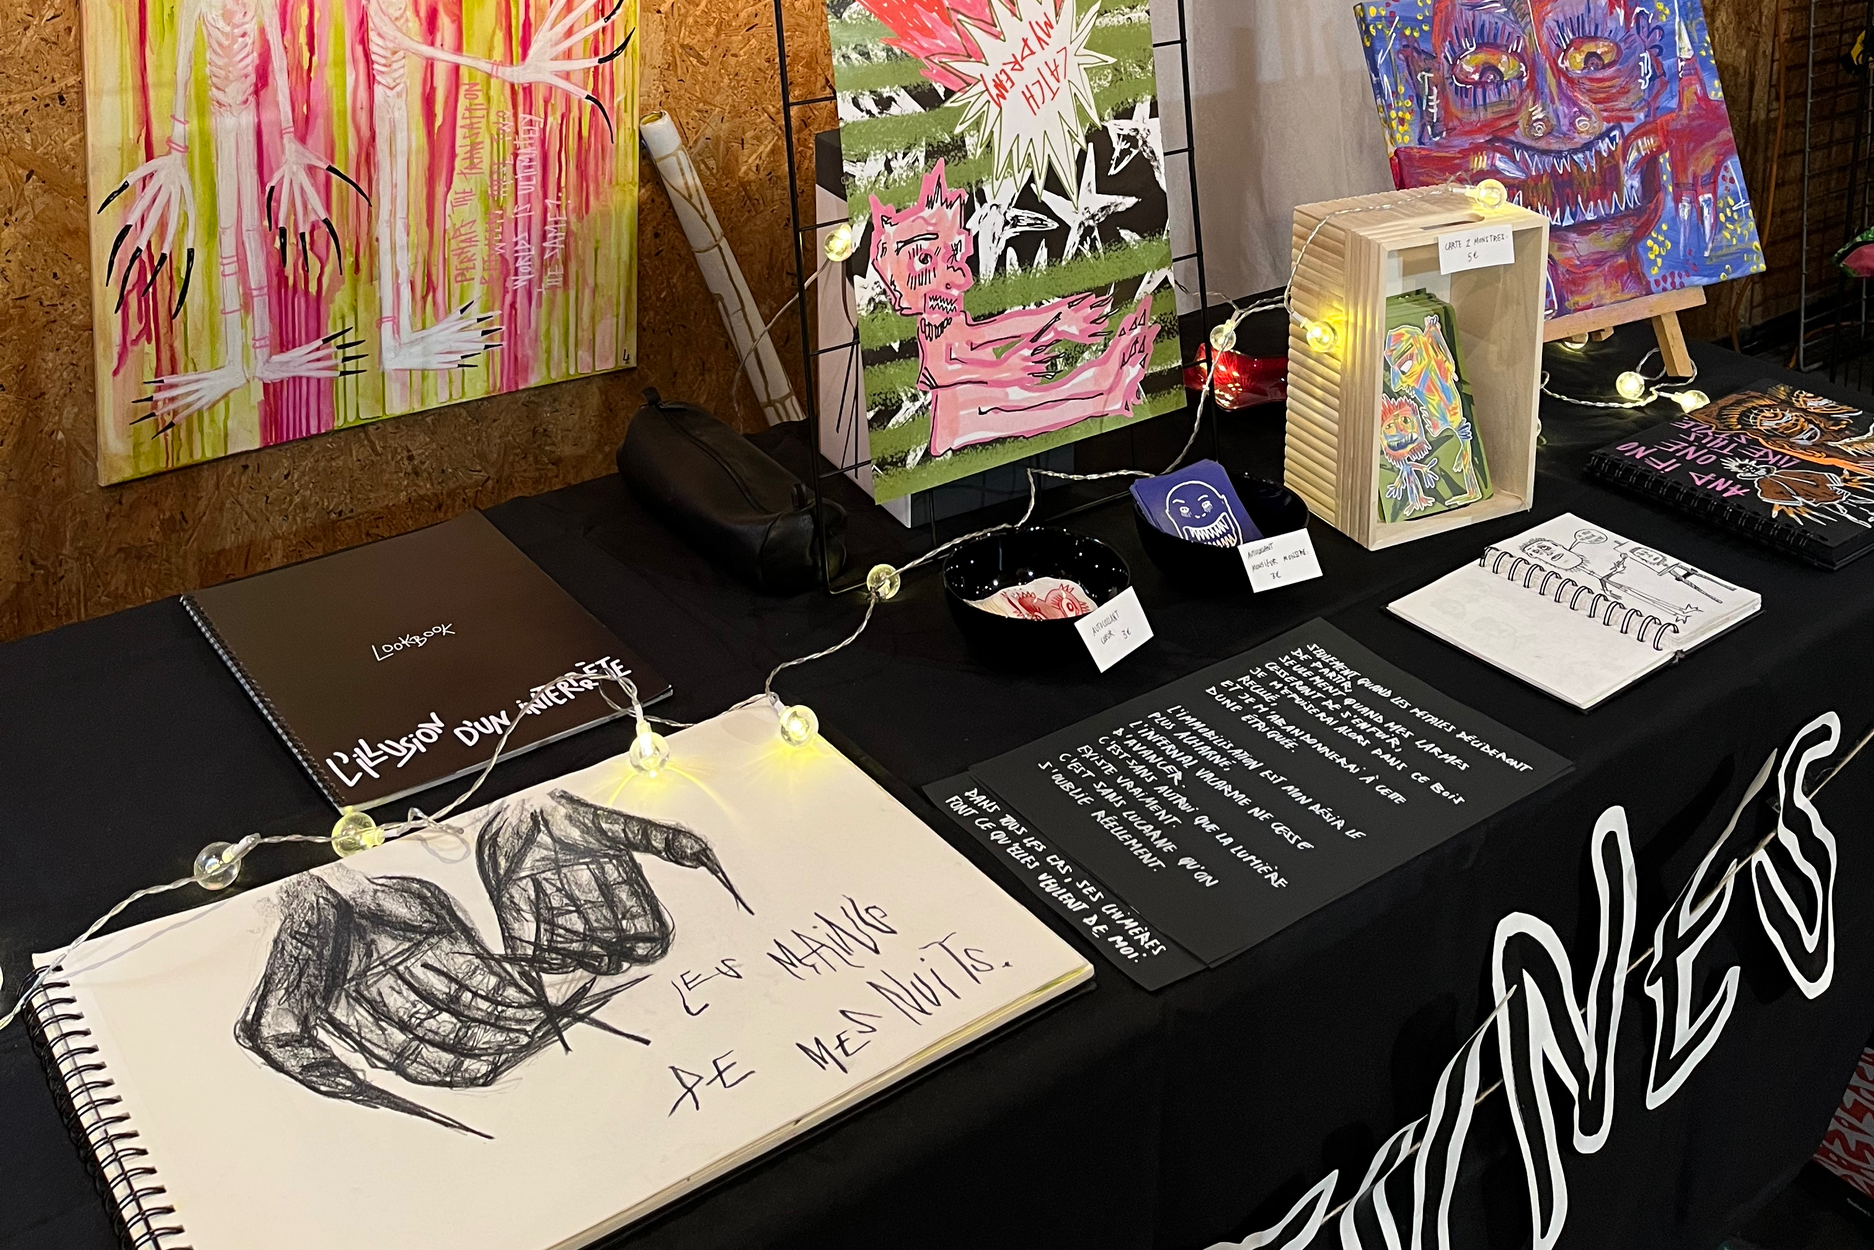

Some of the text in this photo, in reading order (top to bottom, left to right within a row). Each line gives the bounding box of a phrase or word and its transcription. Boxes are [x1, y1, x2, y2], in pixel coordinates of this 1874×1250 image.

[1028, 12, 1054, 50] MY
[1021, 46, 1068, 116] CATCH
[451, 187, 476, 215] THE
[511, 113, 544, 289] WORLDS IS ULTIMATELY
[451, 218, 479, 285] PERHAPS
[1615, 441, 1750, 498] AND IF NO
[1653, 439, 1717, 465] ONE
[1744, 447, 1801, 469] LIKE
[1206, 686, 1242, 711] DUNE
[1309, 660, 1357, 693] PARTIR,
[1357, 678, 1392, 697] QUAND
[1390, 697, 1411, 708] LES
[453, 710, 511, 747] D'UN
[1077, 745, 1118, 775] EXISTE
[1148, 712, 1236, 771] PLUS ACHARNÉ,
[1221, 680, 1243, 691] ET
[1238, 693, 1256, 703] JE
[1359, 771, 1380, 784] À
[1376, 785, 1406, 804] CETTE
[1250, 667, 1267, 678] JE
[1334, 726, 1370, 746] ALORS
[1371, 748, 1407, 770] DANS
[1411, 772, 1430, 783] CE
[1430, 782, 1465, 804] BOIS
[1344, 698, 1383, 723] QUAND
[1384, 722, 1414, 738] MES
[1415, 740, 1469, 770] LARMES
[1038, 762, 1094, 805] S'OUBLIE
[1099, 737, 1288, 887] C'EST SANS AUTRUI QUE LA LUMIÈRE
[1196, 768, 1251, 806] VACARME
[1247, 807, 1274, 821] NE
[1271, 823, 1314, 849] CESSE
[1260, 770, 1287, 783] EST
[1281, 786, 1312, 804] MON
[1308, 804, 1344, 830] DÉSIR
[1345, 829, 1366, 838] LE
[945, 795, 978, 816] FONT
[975, 818, 996, 830] CE
[990, 831, 1039, 869] QU'ELLES
[1038, 873, 1089, 911] VEULENT
[1060, 754, 1218, 887] C'EST SANS LUCARNE QU'ON
[965, 788, 1000, 812] DANS
[999, 814, 1027, 835] TOUS
[1023, 837, 1046, 851] LES
[1076, 880, 1104, 901] SES
[1102, 904, 1166, 955] CHIMÈRES
[796, 1008, 883, 1074] MES
